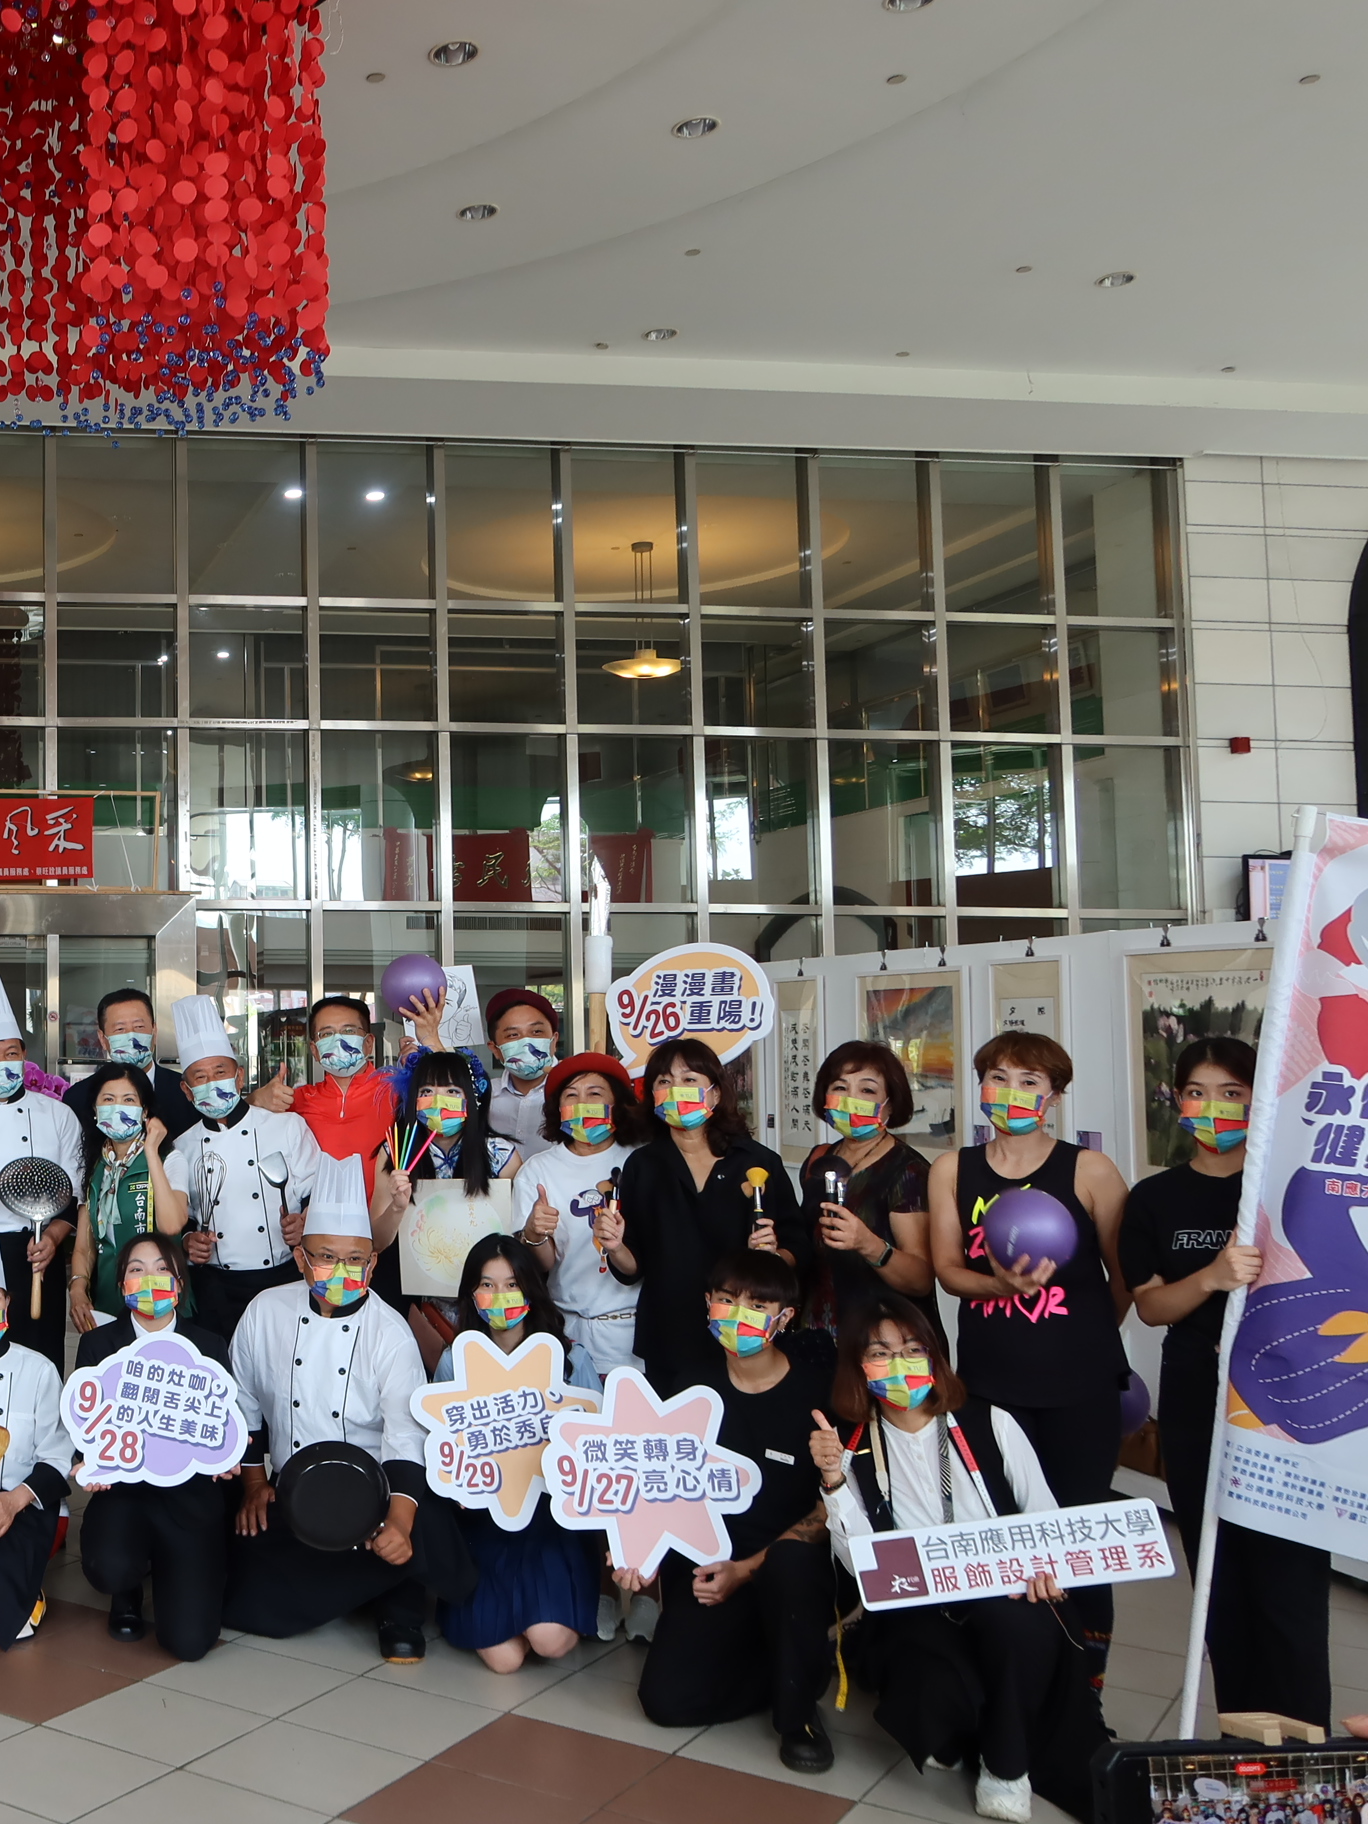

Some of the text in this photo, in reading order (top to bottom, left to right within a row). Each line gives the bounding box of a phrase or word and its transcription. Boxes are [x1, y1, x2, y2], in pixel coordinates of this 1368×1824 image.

[653, 971, 737, 998] 漫漫畫
[617, 989, 681, 1039] 9/26
[134, 1192, 147, 1234] 台南市
[126, 1360, 222, 1392] 咱的灶咖，
[120, 1382, 223, 1419] 翻閱舌尖上
[78, 1381, 139, 1464] 9/28
[116, 1405, 219, 1442] 的人生美味
[439, 1441, 495, 1488] 9/29
[582, 1438, 700, 1464] 微笑轉身
[557, 1455, 635, 1508] 9/27
[643, 1467, 733, 1494] 亮心情
[921, 1507, 1157, 1563] 台南應用科技大學
[930, 1540, 1167, 1594] 服飾設計管理系
